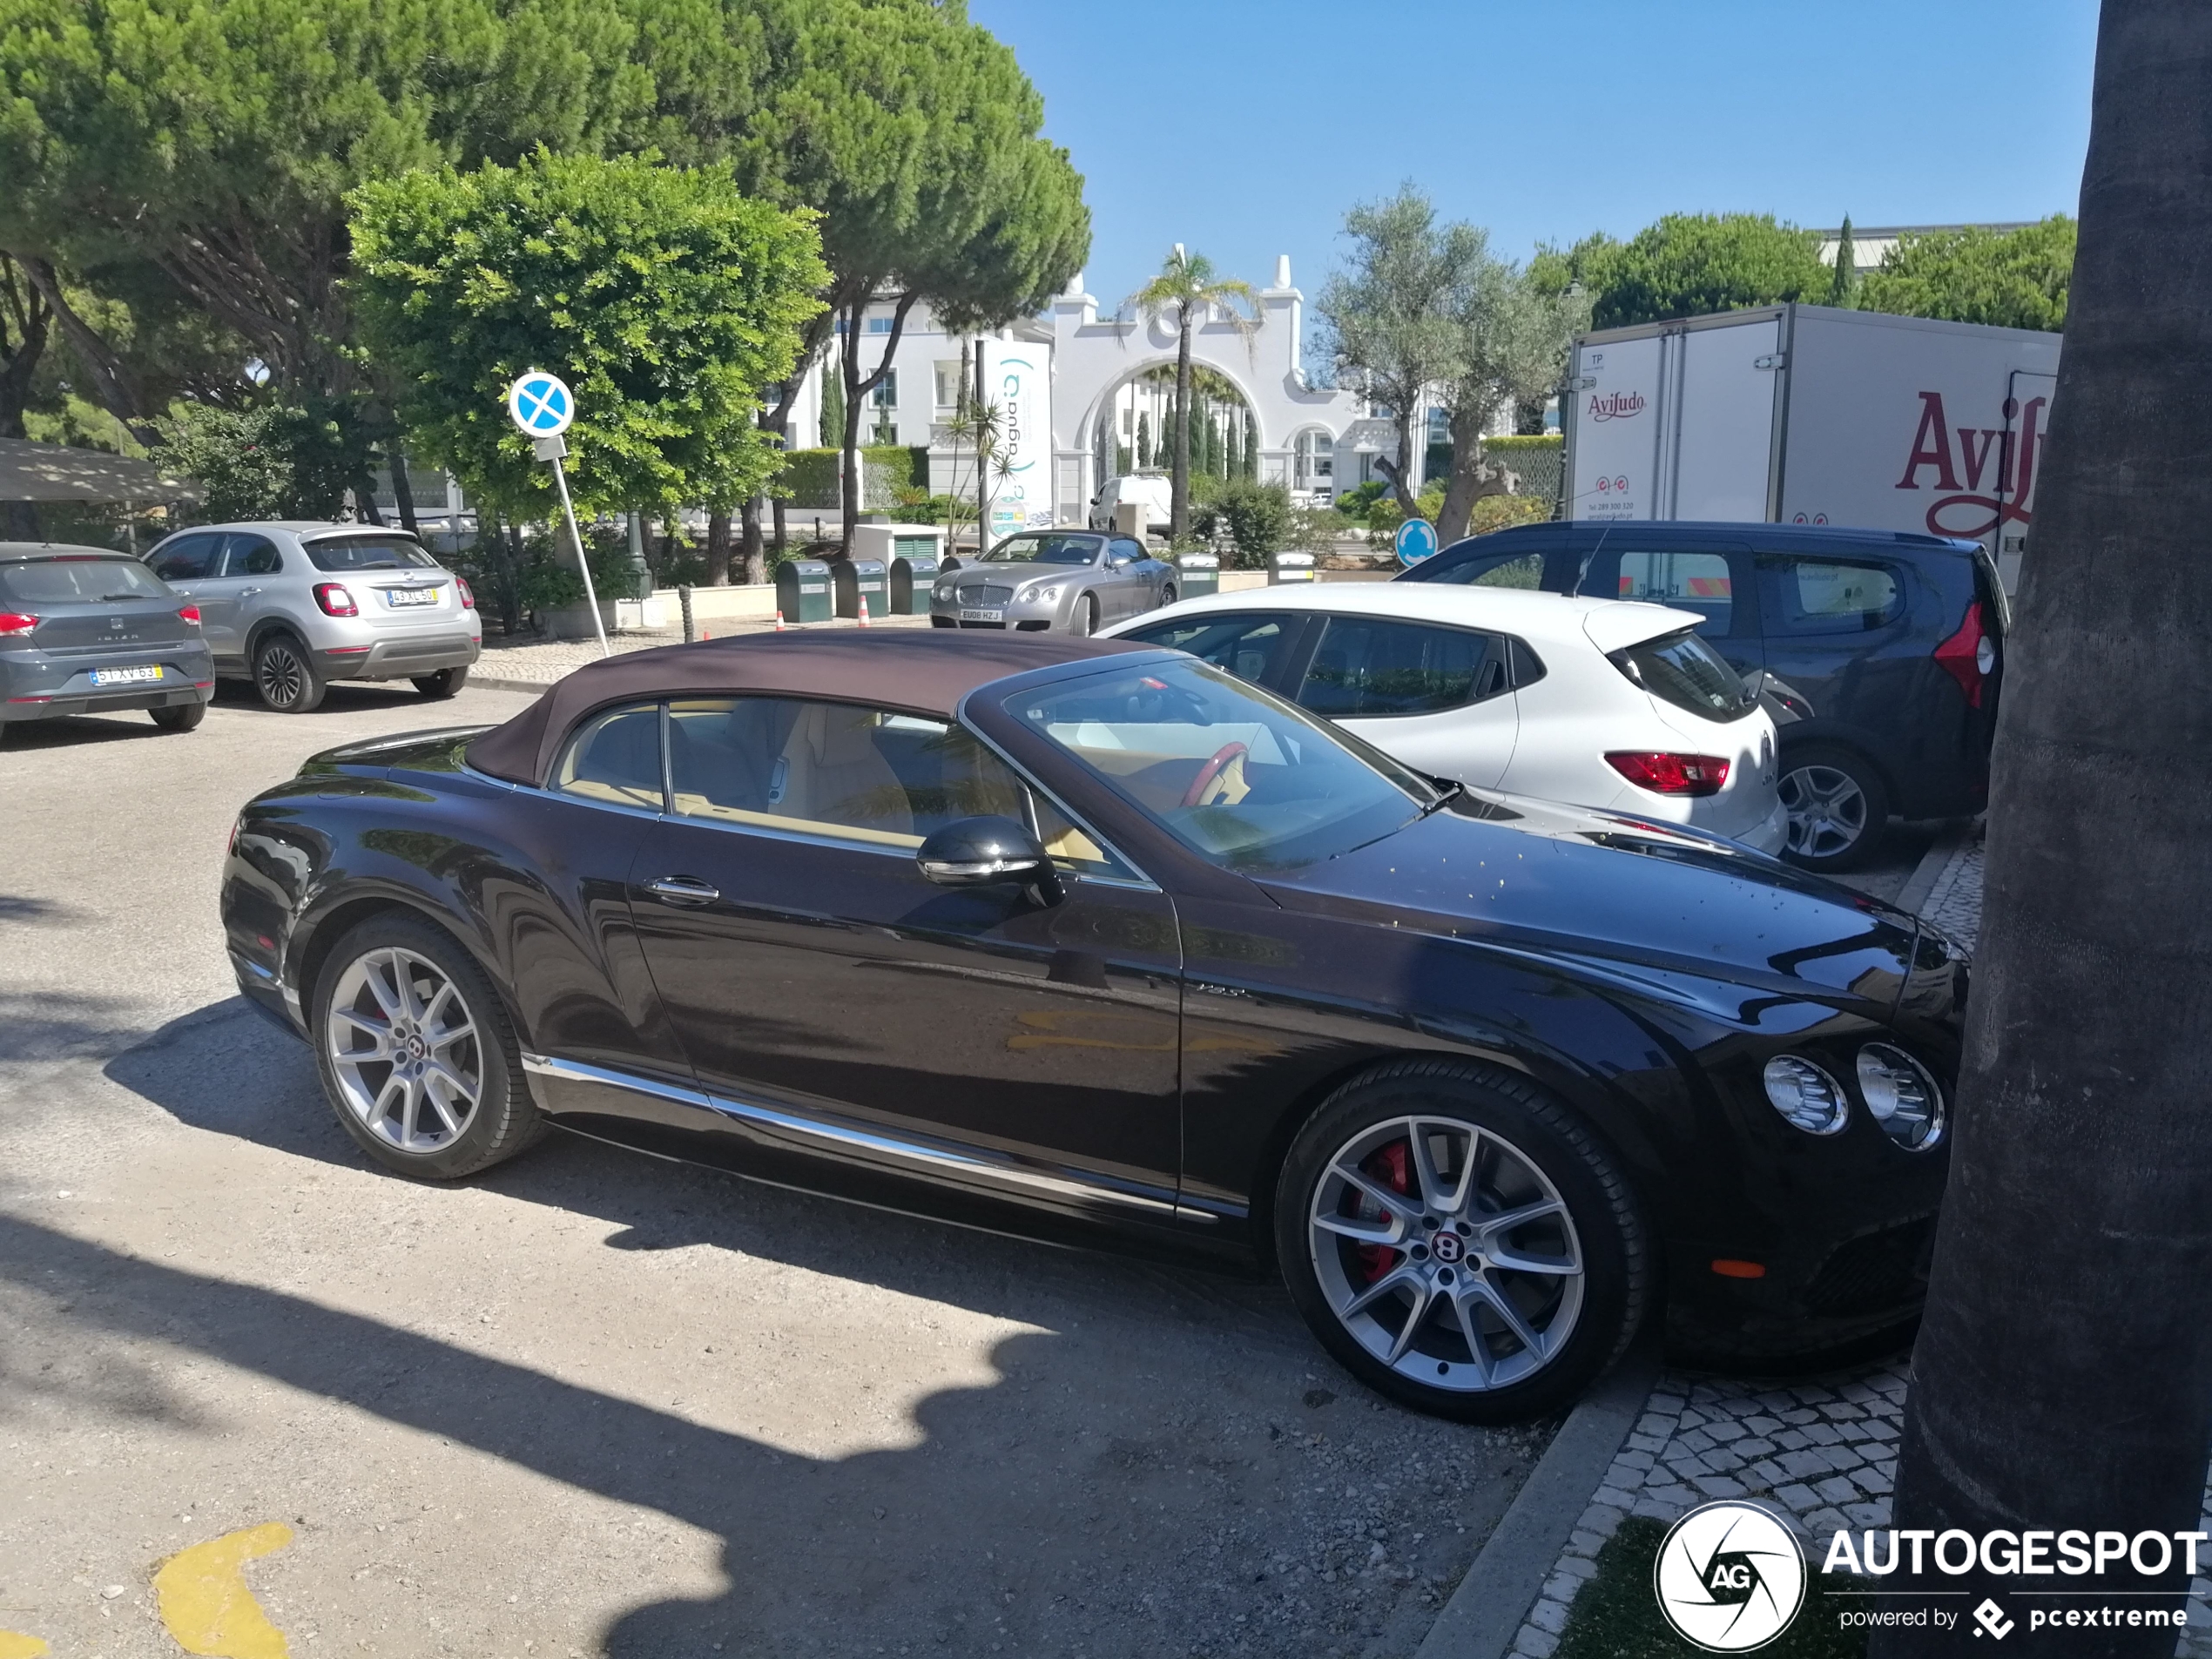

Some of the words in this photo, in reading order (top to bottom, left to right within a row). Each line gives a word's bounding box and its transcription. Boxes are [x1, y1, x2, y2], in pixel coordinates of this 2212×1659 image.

[1591, 354, 1603, 365] TP
[963, 610, 981, 619] EU08
[982, 611, 999, 620] HZJ
